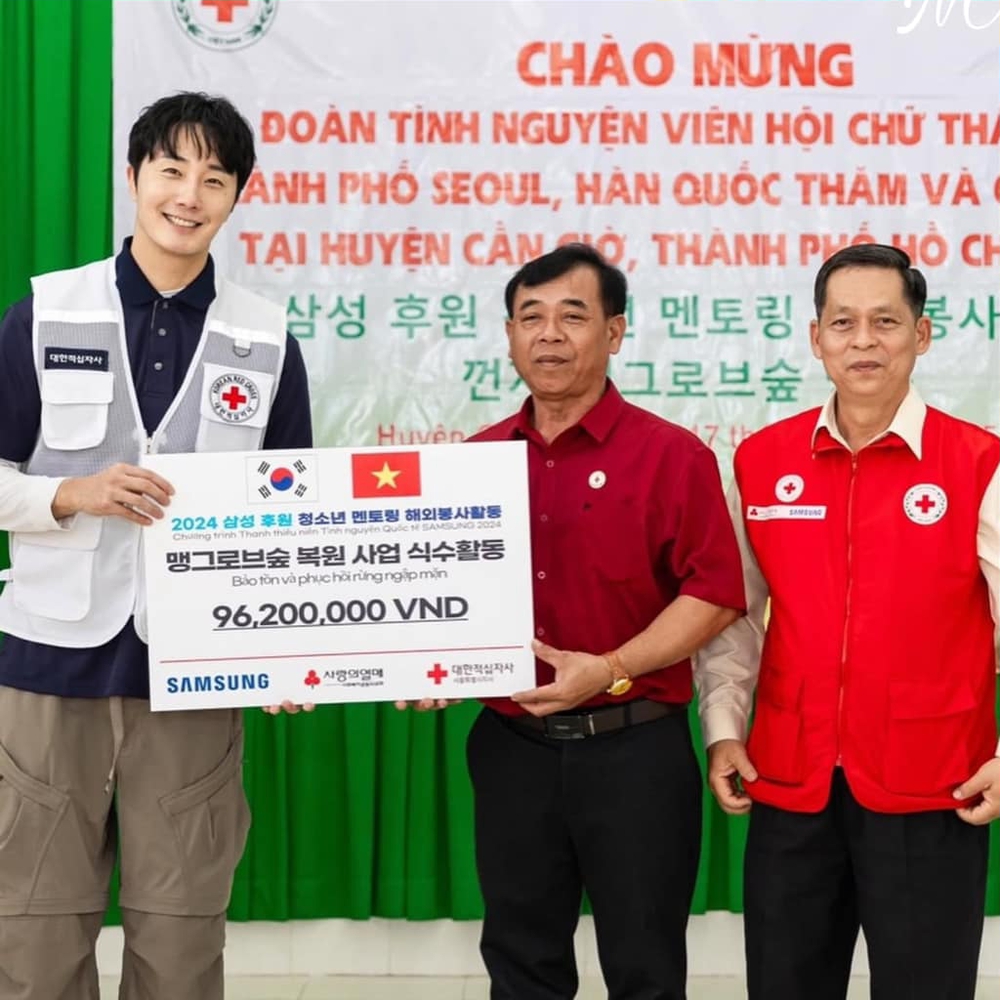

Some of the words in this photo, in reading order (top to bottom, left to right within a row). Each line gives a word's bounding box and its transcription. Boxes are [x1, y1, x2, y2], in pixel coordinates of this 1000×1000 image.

[516, 34, 675, 87] CHÀO
[693, 34, 854, 88] MỪNG
[260, 104, 376, 144] ĐOÀN
[389, 104, 479, 144] TÌNH
[492, 104, 648, 151] NGUYỆN
[661, 105, 752, 145] VIÊN
[766, 105, 833, 151] HỘI
[848, 104, 927, 146] CHỮ
[339, 159, 419, 205] PHỐ
[431, 171, 562, 211] SEOUL,
[576, 166, 660, 206] HÀN
[673, 159, 782, 206] QUỐC
[795, 166, 907, 206] THĂM
[922, 166, 980, 206] VÀ
[239, 231, 307, 273] TẠI
[320, 226, 450, 273] HUYỆN
[463, 220, 544, 267] CẦN
[651, 225, 786, 267] THÀNH
[891, 220, 948, 268] HỒ
[287, 293, 367, 339] 삼성
[390, 293, 478, 339] 후원
[660, 294, 793, 340] 멘토링
[49, 354, 102, 365] 대한적십자사
[171, 516, 218, 531] 2024
[223, 514, 255, 529] 삼성
[261, 512, 293, 527] 후원
[298, 511, 346, 526] 청소년
[352, 509, 399, 524] 멘토링
[405, 505, 502, 521] 해외봉사활동
[240, 529, 271, 538] Thanh
[422, 522, 474, 532] SAMSUNG
[477, 521, 501, 530] 2024
[166, 547, 290, 573] 맹그로브숲
[297, 545, 345, 567] 복원
[352, 542, 400, 565] 사업
[407, 539, 505, 562] 식수활동
[212, 600, 387, 629] 96,200,000
[393, 596, 468, 620] VND
[167, 672, 269, 694] SAMSUNG
[452, 662, 514, 675] 대한적십자사
